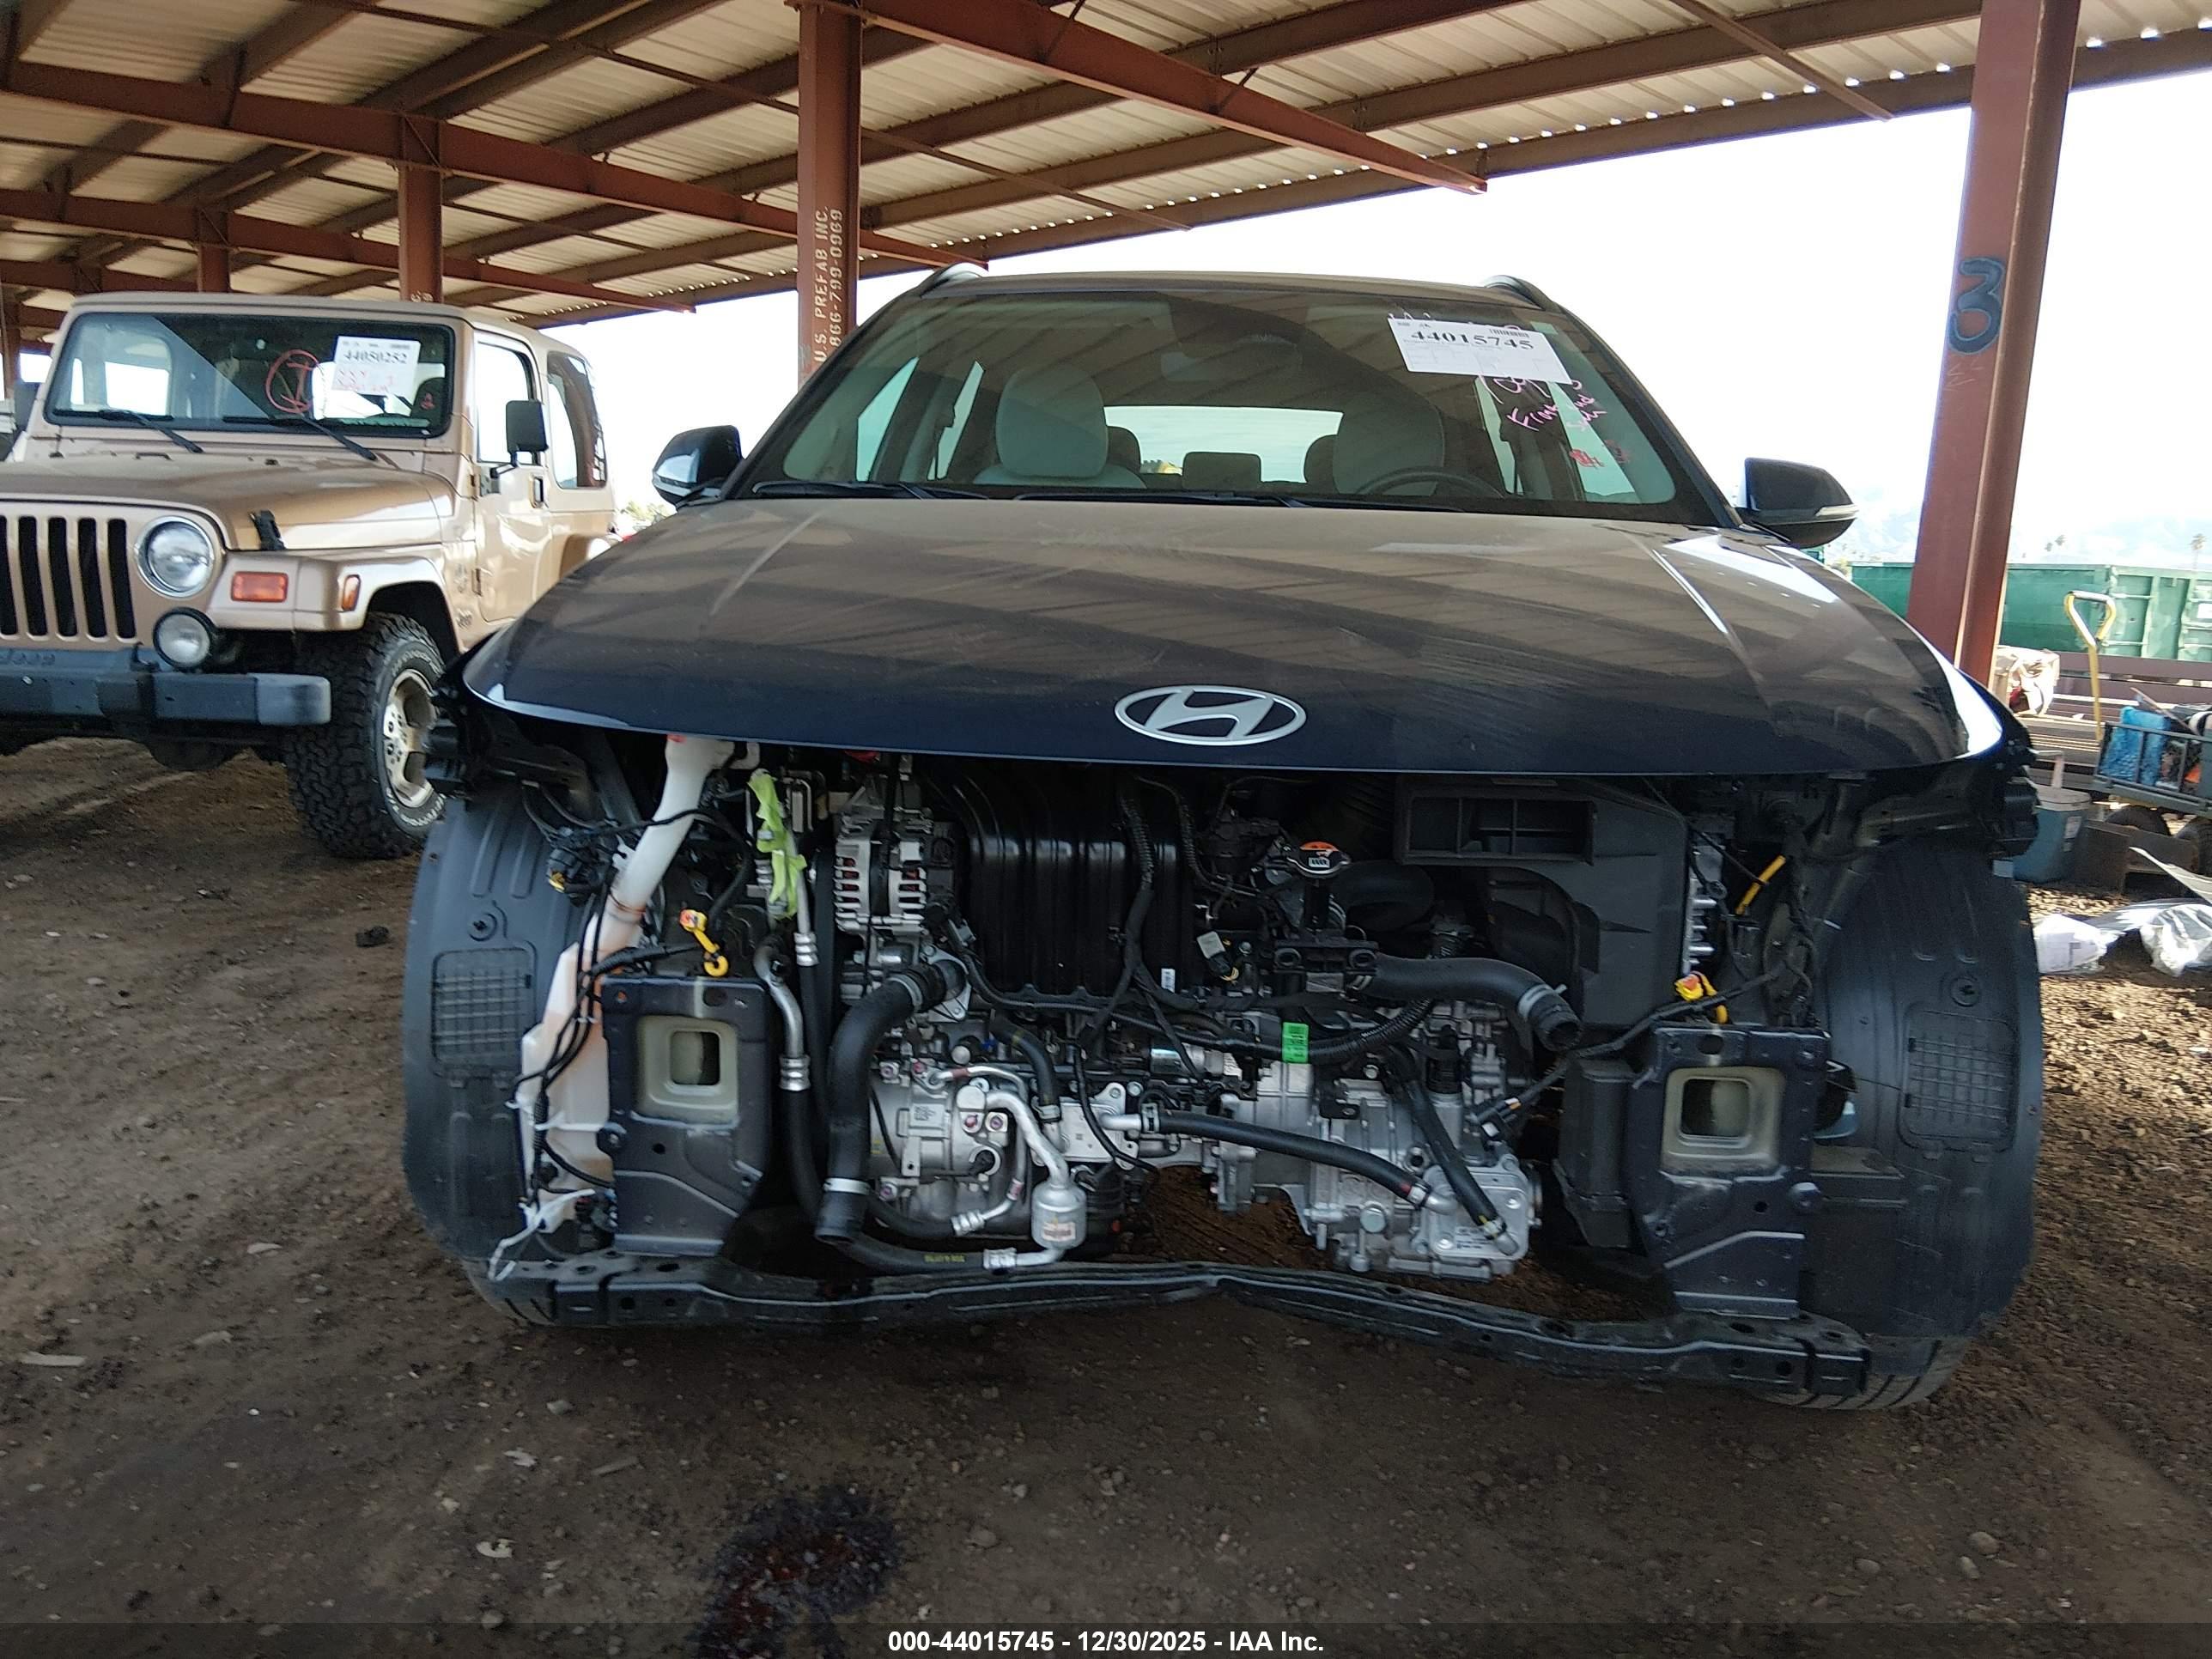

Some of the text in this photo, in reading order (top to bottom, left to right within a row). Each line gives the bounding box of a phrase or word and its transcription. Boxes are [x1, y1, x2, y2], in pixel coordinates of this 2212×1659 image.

[815, 206, 829, 240] INC.
[814, 247, 828, 319] PREFAB
[829, 209, 843, 347] 866-799-0969
[1948, 257, 2005, 356] 3
[343, 349, 408, 364] 44050252
[1411, 331, 1534, 350] 44015745
